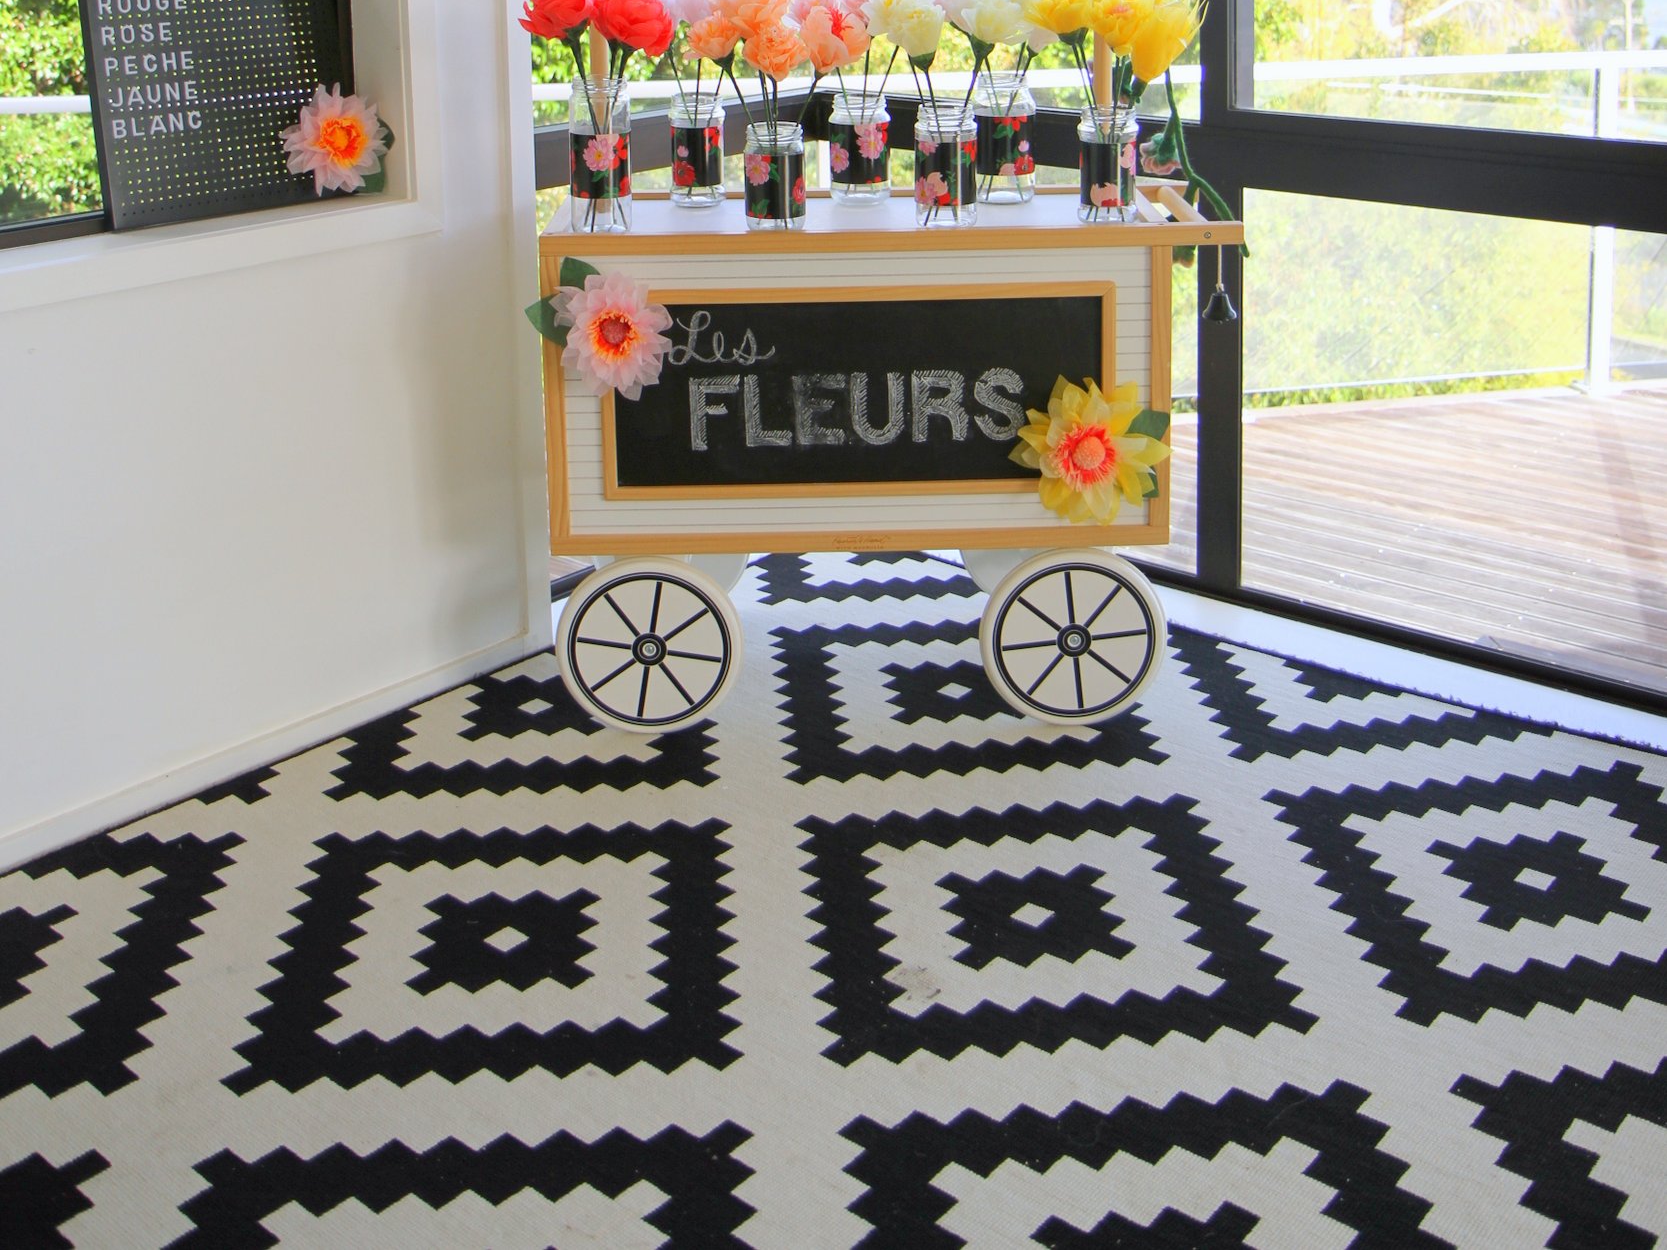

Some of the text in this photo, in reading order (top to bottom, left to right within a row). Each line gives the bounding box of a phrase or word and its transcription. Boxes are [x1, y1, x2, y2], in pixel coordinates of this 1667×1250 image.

[101, 22, 173, 47] ROSE
[104, 50, 195, 77] PECHE
[110, 80, 199, 108] JAUNE
[113, 111, 203, 140] BLANC
[668, 309, 776, 366] Les
[688, 366, 1026, 452] FLEURS
